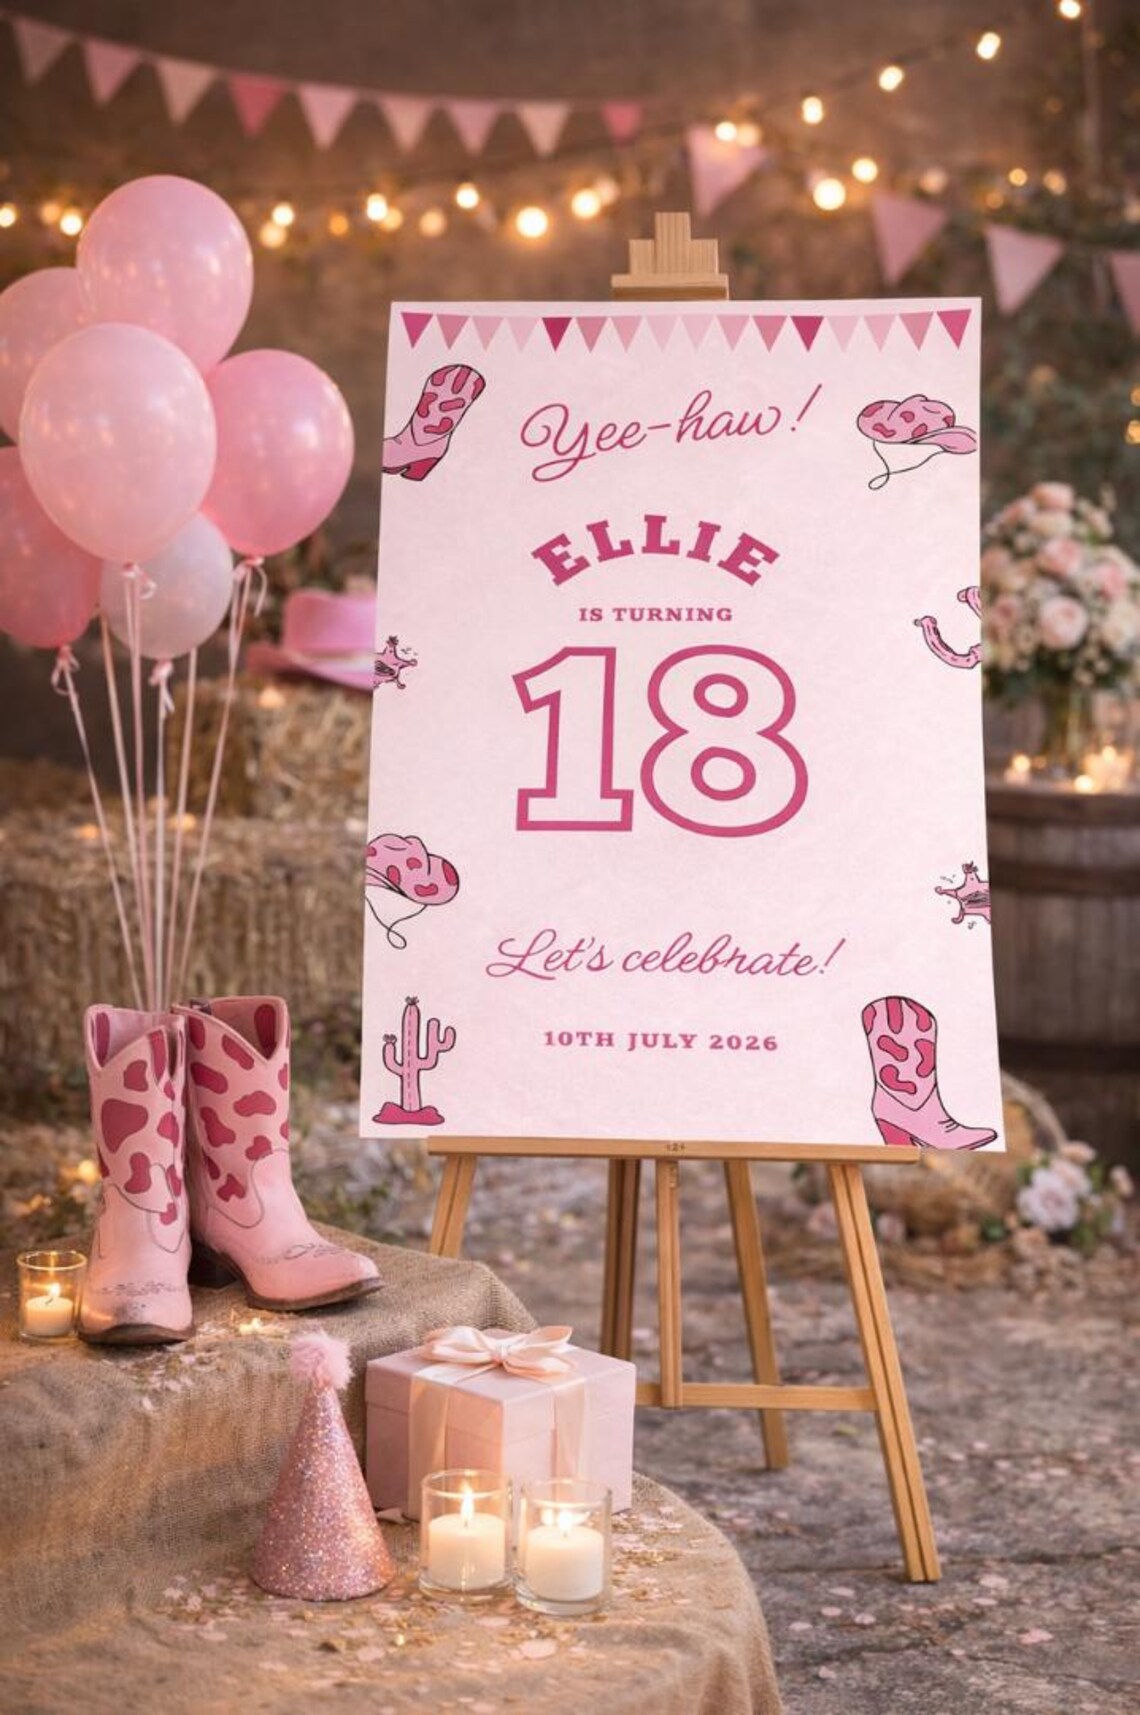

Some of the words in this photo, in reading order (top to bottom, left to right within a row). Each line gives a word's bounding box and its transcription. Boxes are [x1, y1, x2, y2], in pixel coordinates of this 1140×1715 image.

[532, 514, 780, 586] ELLIE
[579, 608, 604, 622] IS
[613, 607, 732, 624] TURNING
[512, 644, 808, 838] 18
[485, 929, 613, 981] Let's
[621, 932, 847, 976] celebrate!
[546, 1031, 615, 1047] 10TH
[628, 1032, 697, 1052] JULY
[710, 1035, 779, 1051] 2026
